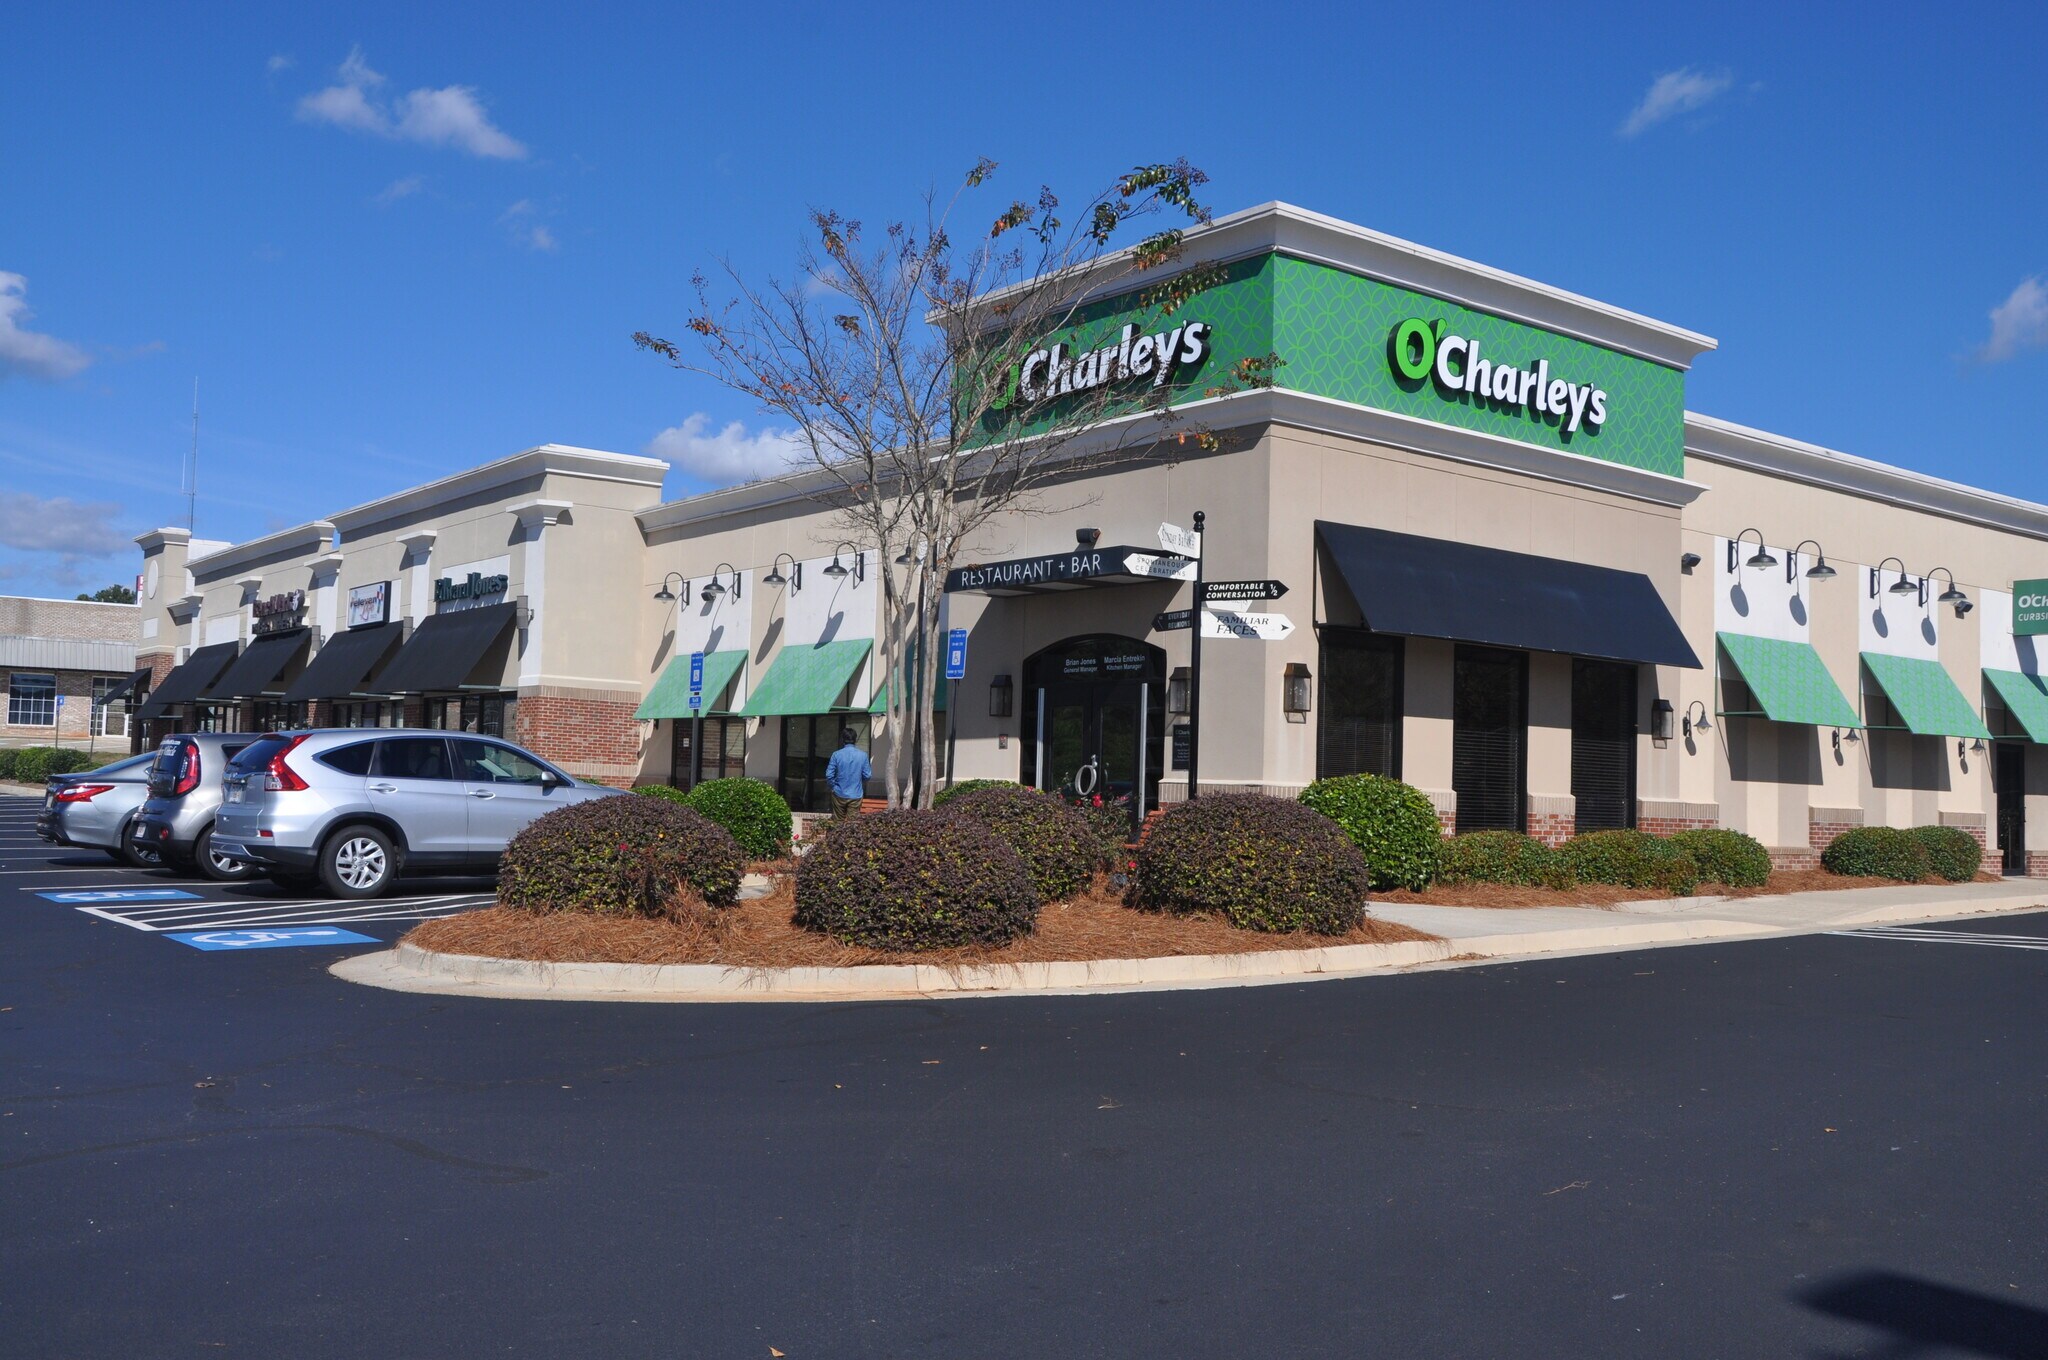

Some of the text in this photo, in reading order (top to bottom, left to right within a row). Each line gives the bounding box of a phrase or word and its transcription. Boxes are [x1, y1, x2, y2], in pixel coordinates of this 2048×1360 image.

[1394, 317, 1608, 432] O'Charley's
[1136, 557, 1185, 569] SPONTANEOUS
[961, 559, 1054, 587] RESTAURANT
[1071, 553, 1102, 574] BAR
[1135, 565, 1186, 577] CELEBRATIONS
[471, 573, 506, 599] Jones
[1208, 583, 1264, 591] COMFORTABLE
[1206, 591, 1266, 599] CONVERSATION
[1216, 615, 1269, 625] FAMILIAR
[1216, 624, 1258, 636] FACES
[1065, 657, 1096, 666] Brian Jones
[1104, 655, 1121, 664] Marcia
